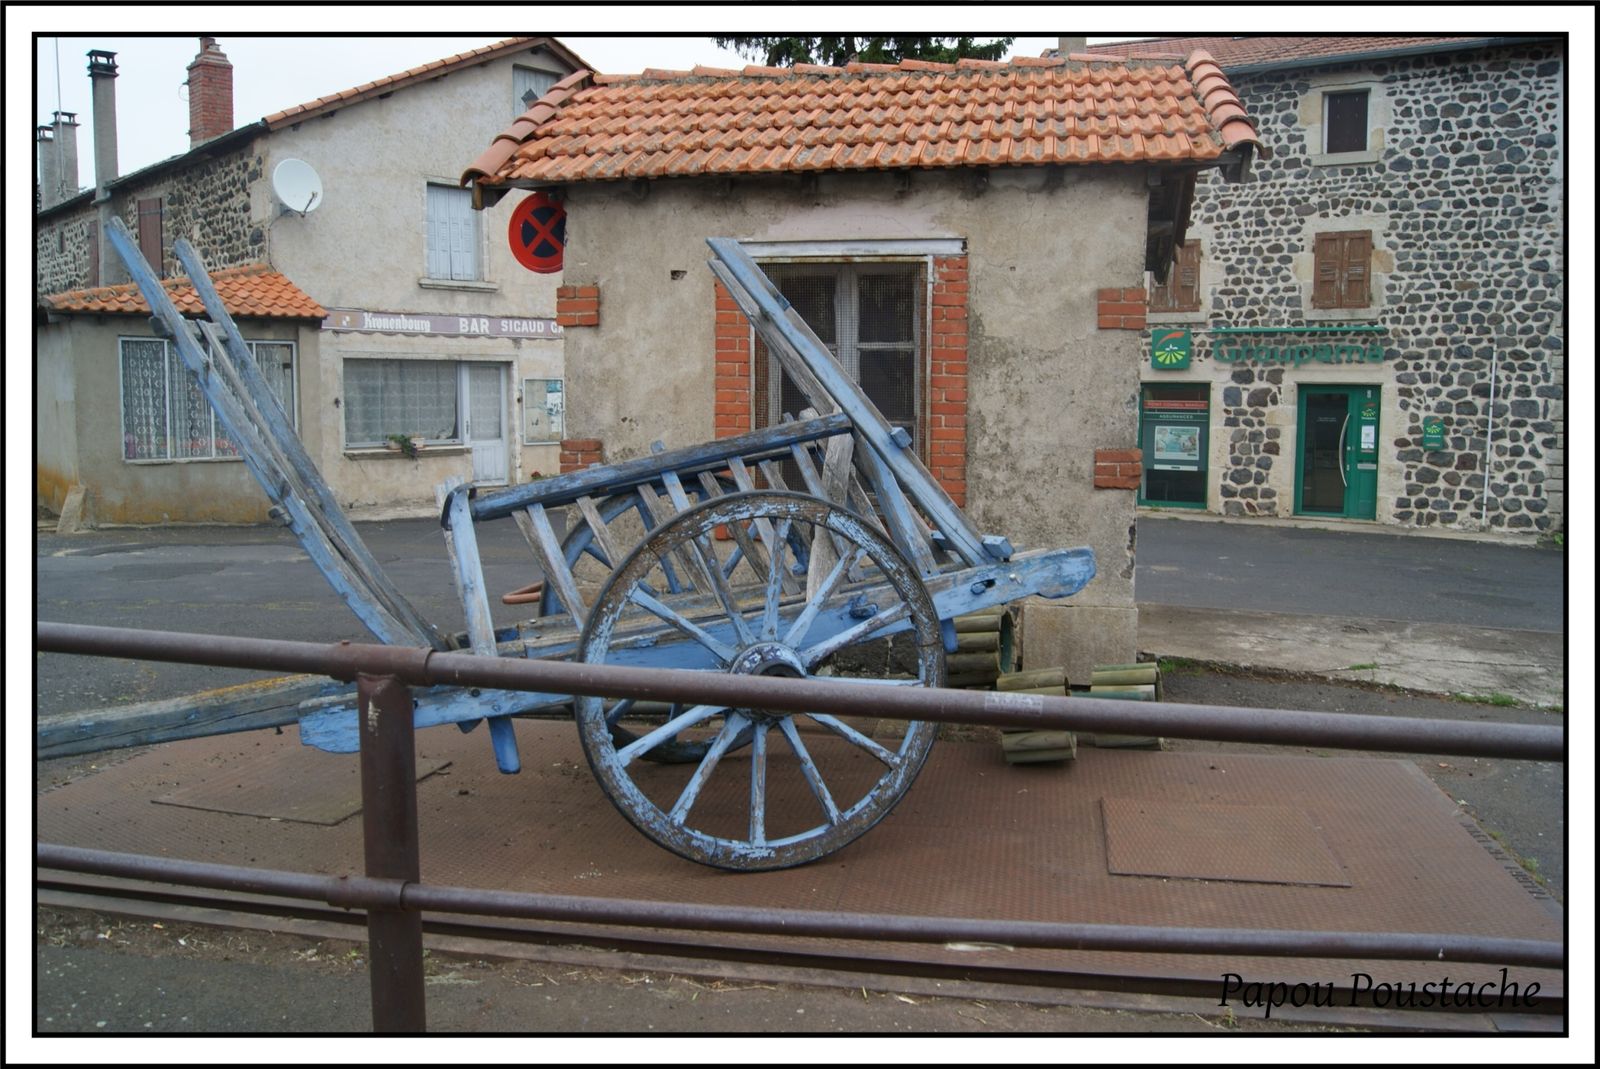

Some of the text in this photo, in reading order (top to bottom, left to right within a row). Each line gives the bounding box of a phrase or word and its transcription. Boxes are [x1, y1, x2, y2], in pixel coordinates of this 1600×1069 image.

[363, 312, 431, 332] Kronenbourg
[459, 317, 490, 334] BAR
[501, 319, 545, 333] SICAUD
[1212, 337, 1385, 368] Groupama
